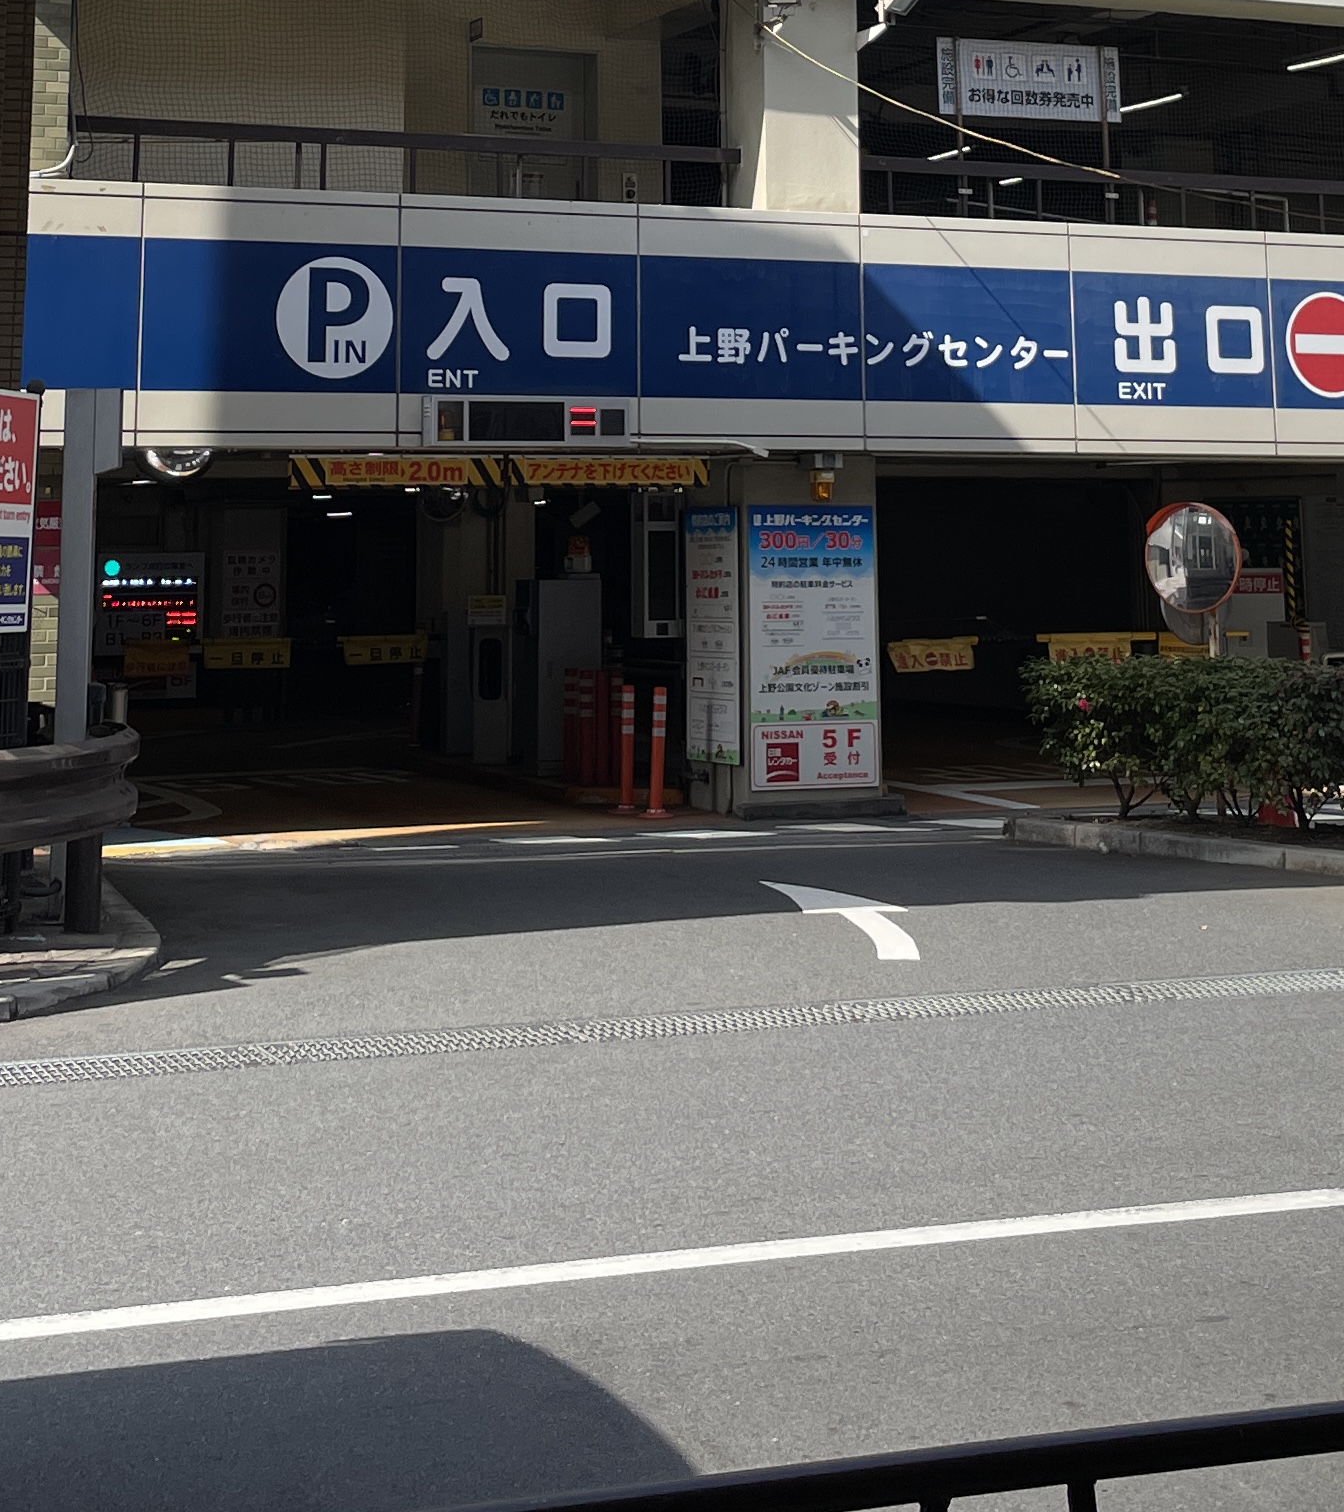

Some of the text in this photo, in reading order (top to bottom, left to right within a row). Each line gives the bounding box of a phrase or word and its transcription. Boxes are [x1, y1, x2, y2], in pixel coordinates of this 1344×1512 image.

[967, 87, 1094, 109] お得な回数券発売中
[489, 109, 557, 123] だれでもトイレ
[307, 267, 370, 363] P
[426, 276, 612, 362] 入口
[1113, 296, 1265, 374] 出口
[333, 338, 367, 364] IN
[677, 325, 1070, 370] 上野パーキングセンター
[427, 368, 479, 389] ENT
[1117, 381, 1166, 401] EXIT
[330, 461, 463, 481] 高さ制限 2.0m
[528, 463, 690, 481] アンテナを下げてください
[4, 509, 15, 520] turn
[16, 510, 31, 523] entry
[763, 513, 869, 526] 上野パーキングセンター
[1238, 577, 1280, 592] 時停止
[208, 650, 285, 666] 一旦停止
[348, 645, 423, 661] 一旦停止
[761, 730, 804, 740] NISSAN
[823, 751, 861, 767] 受付
[816, 771, 869, 781] Acceptance
